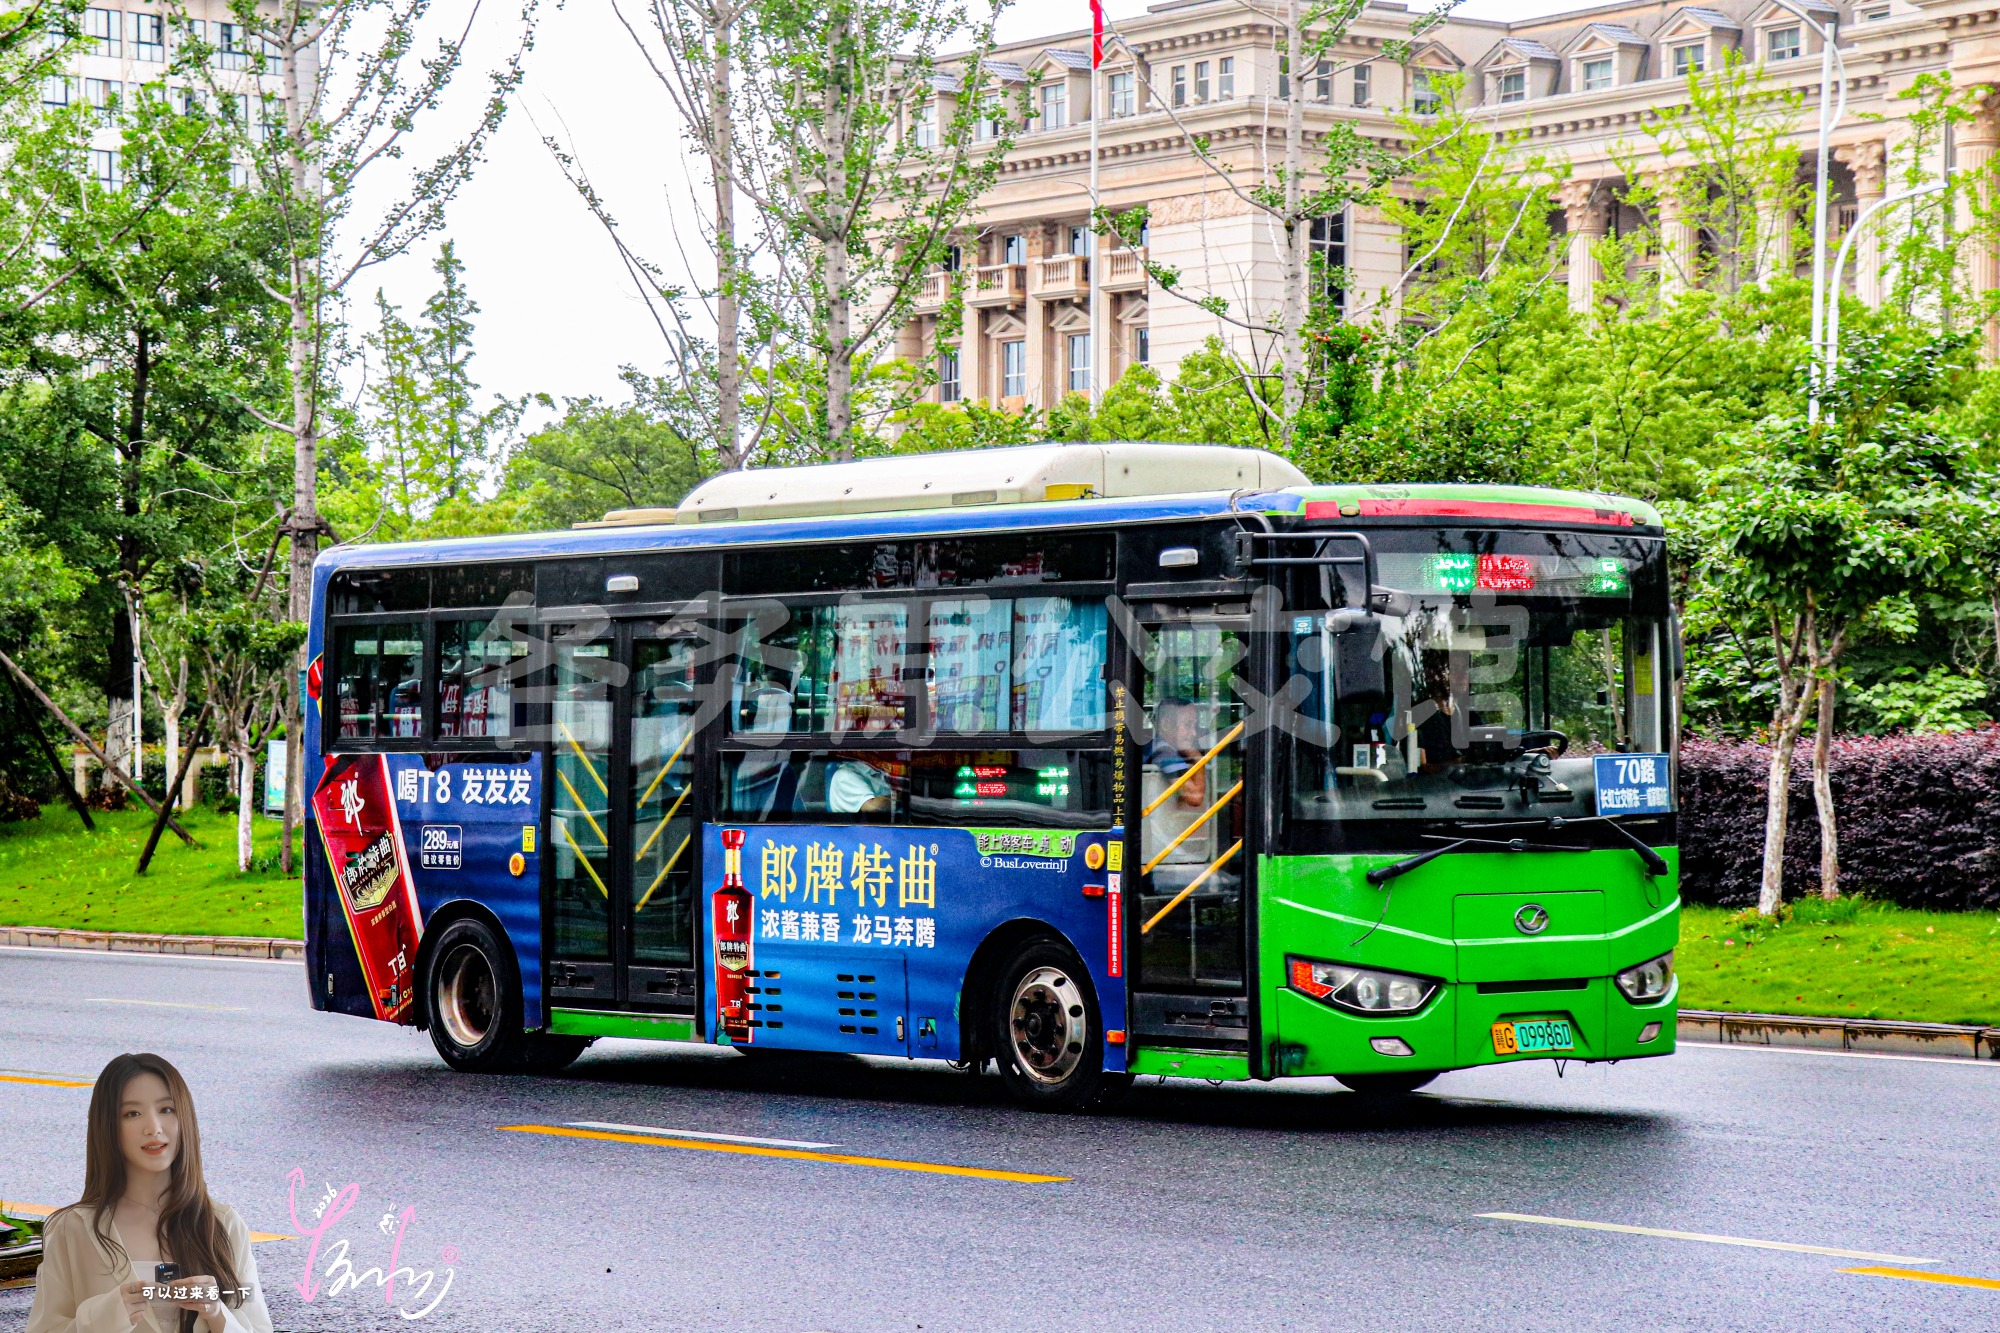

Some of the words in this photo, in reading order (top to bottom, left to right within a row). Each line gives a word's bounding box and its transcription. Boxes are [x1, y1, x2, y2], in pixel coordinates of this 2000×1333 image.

[1615, 758, 1656, 784] 70路
[397, 768, 451, 804] 喝T8
[462, 767, 532, 805] 发发发
[423, 854, 460, 867] 建议零售价
[761, 909, 840, 943] 浓酱兼香
[852, 914, 936, 948] 龙马奔腾
[720, 941, 747, 953] 郎牌特曲
[388, 950, 407, 976] T8
